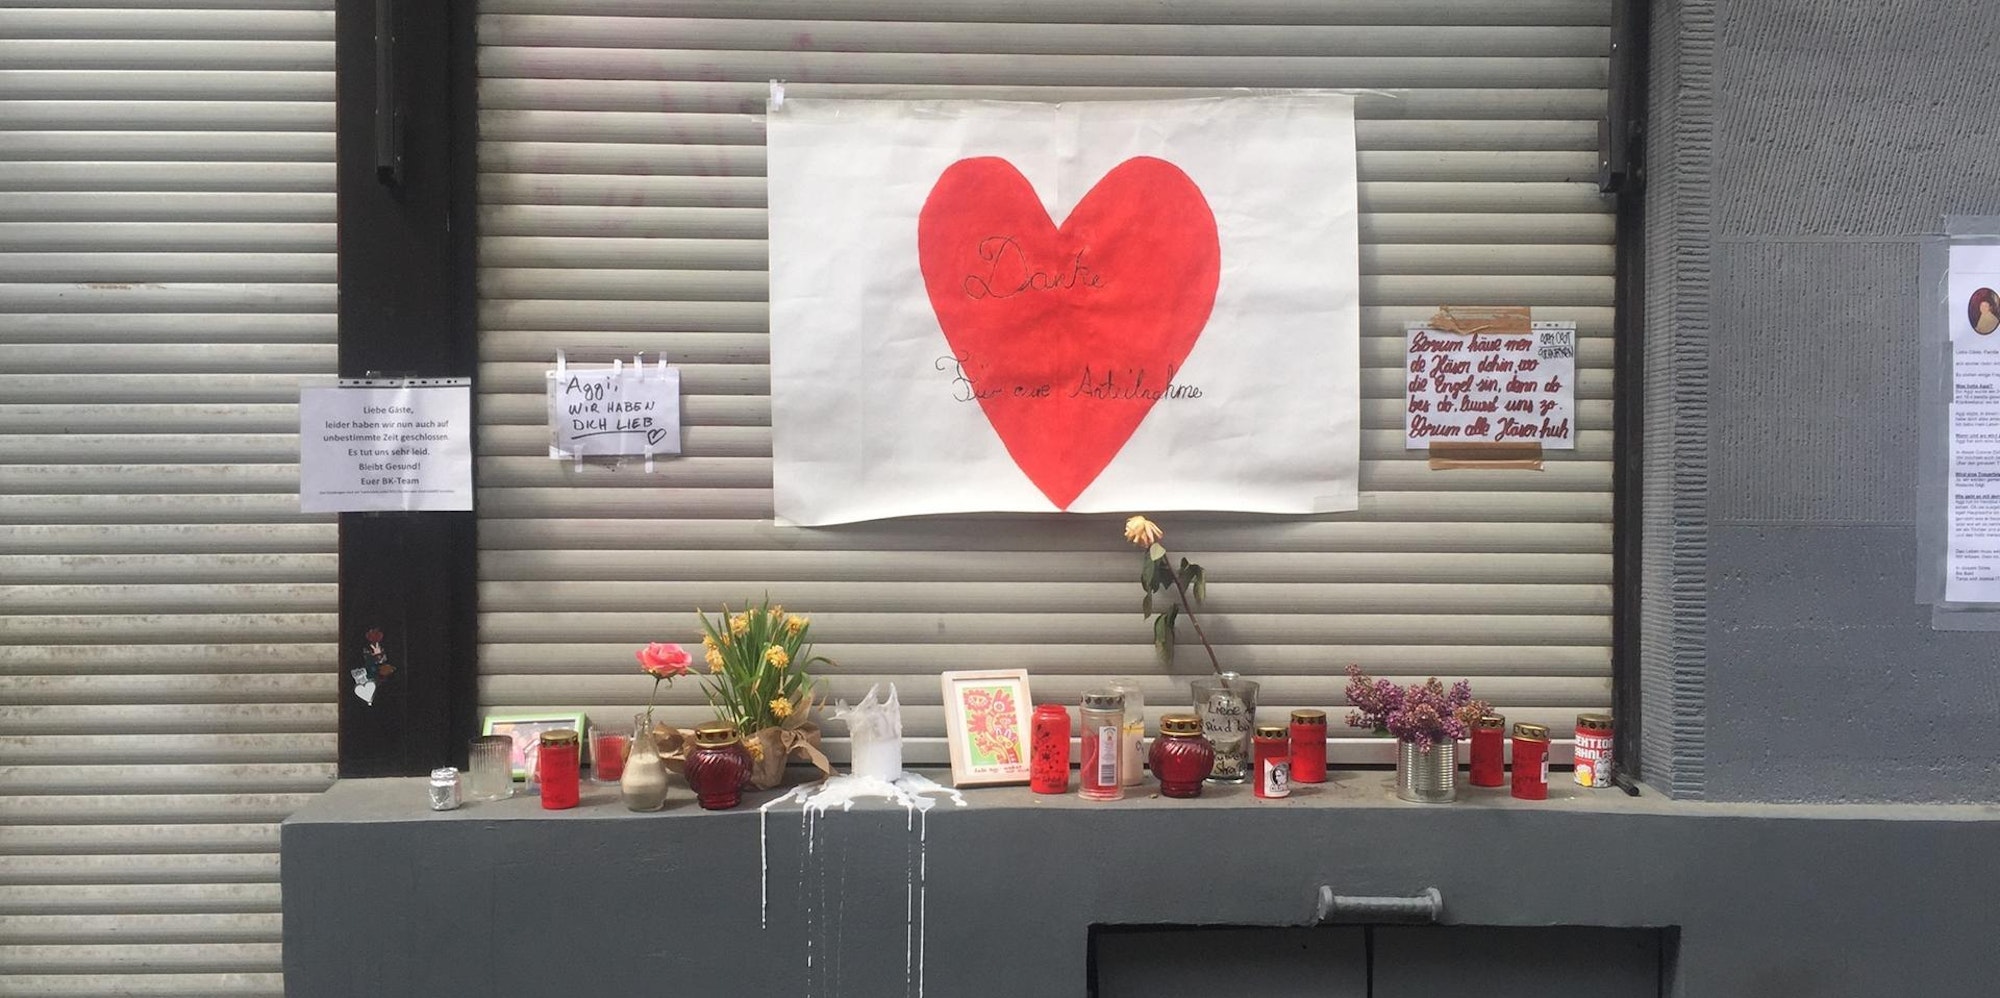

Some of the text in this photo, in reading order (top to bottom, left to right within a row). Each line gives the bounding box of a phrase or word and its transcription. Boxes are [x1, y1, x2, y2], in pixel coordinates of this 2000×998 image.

[964, 236, 1107, 300] Danke
[935, 350, 1003, 403] Für
[1069, 364, 1204, 401] Anteilnahme
[565, 375, 619, 401] Aggi,
[1408, 374, 1429, 393] die
[1433, 374, 1475, 400] Engel
[363, 405, 414, 415] Liebe Gäste,
[568, 400, 655, 416] WIR HABEN
[325, 420, 350, 429] leider
[352, 420, 380, 429] haben
[381, 421, 395, 429] wir
[415, 420, 436, 428] auch
[437, 420, 449, 428] auf
[573, 416, 654, 431] DICH LIEB
[1464, 416, 1491, 436] alle
[323, 434, 381, 442] unbestimmte
[383, 433, 399, 441] Zeit
[348, 448, 358, 456] Es
[391, 447, 411, 456] sehr
[411, 447, 431, 456] leid.
[358, 461, 421, 471] Bleibt Gesund!
[360, 476, 420, 486] Euer BK-Team
[1207, 700, 1241, 716] Liebe
